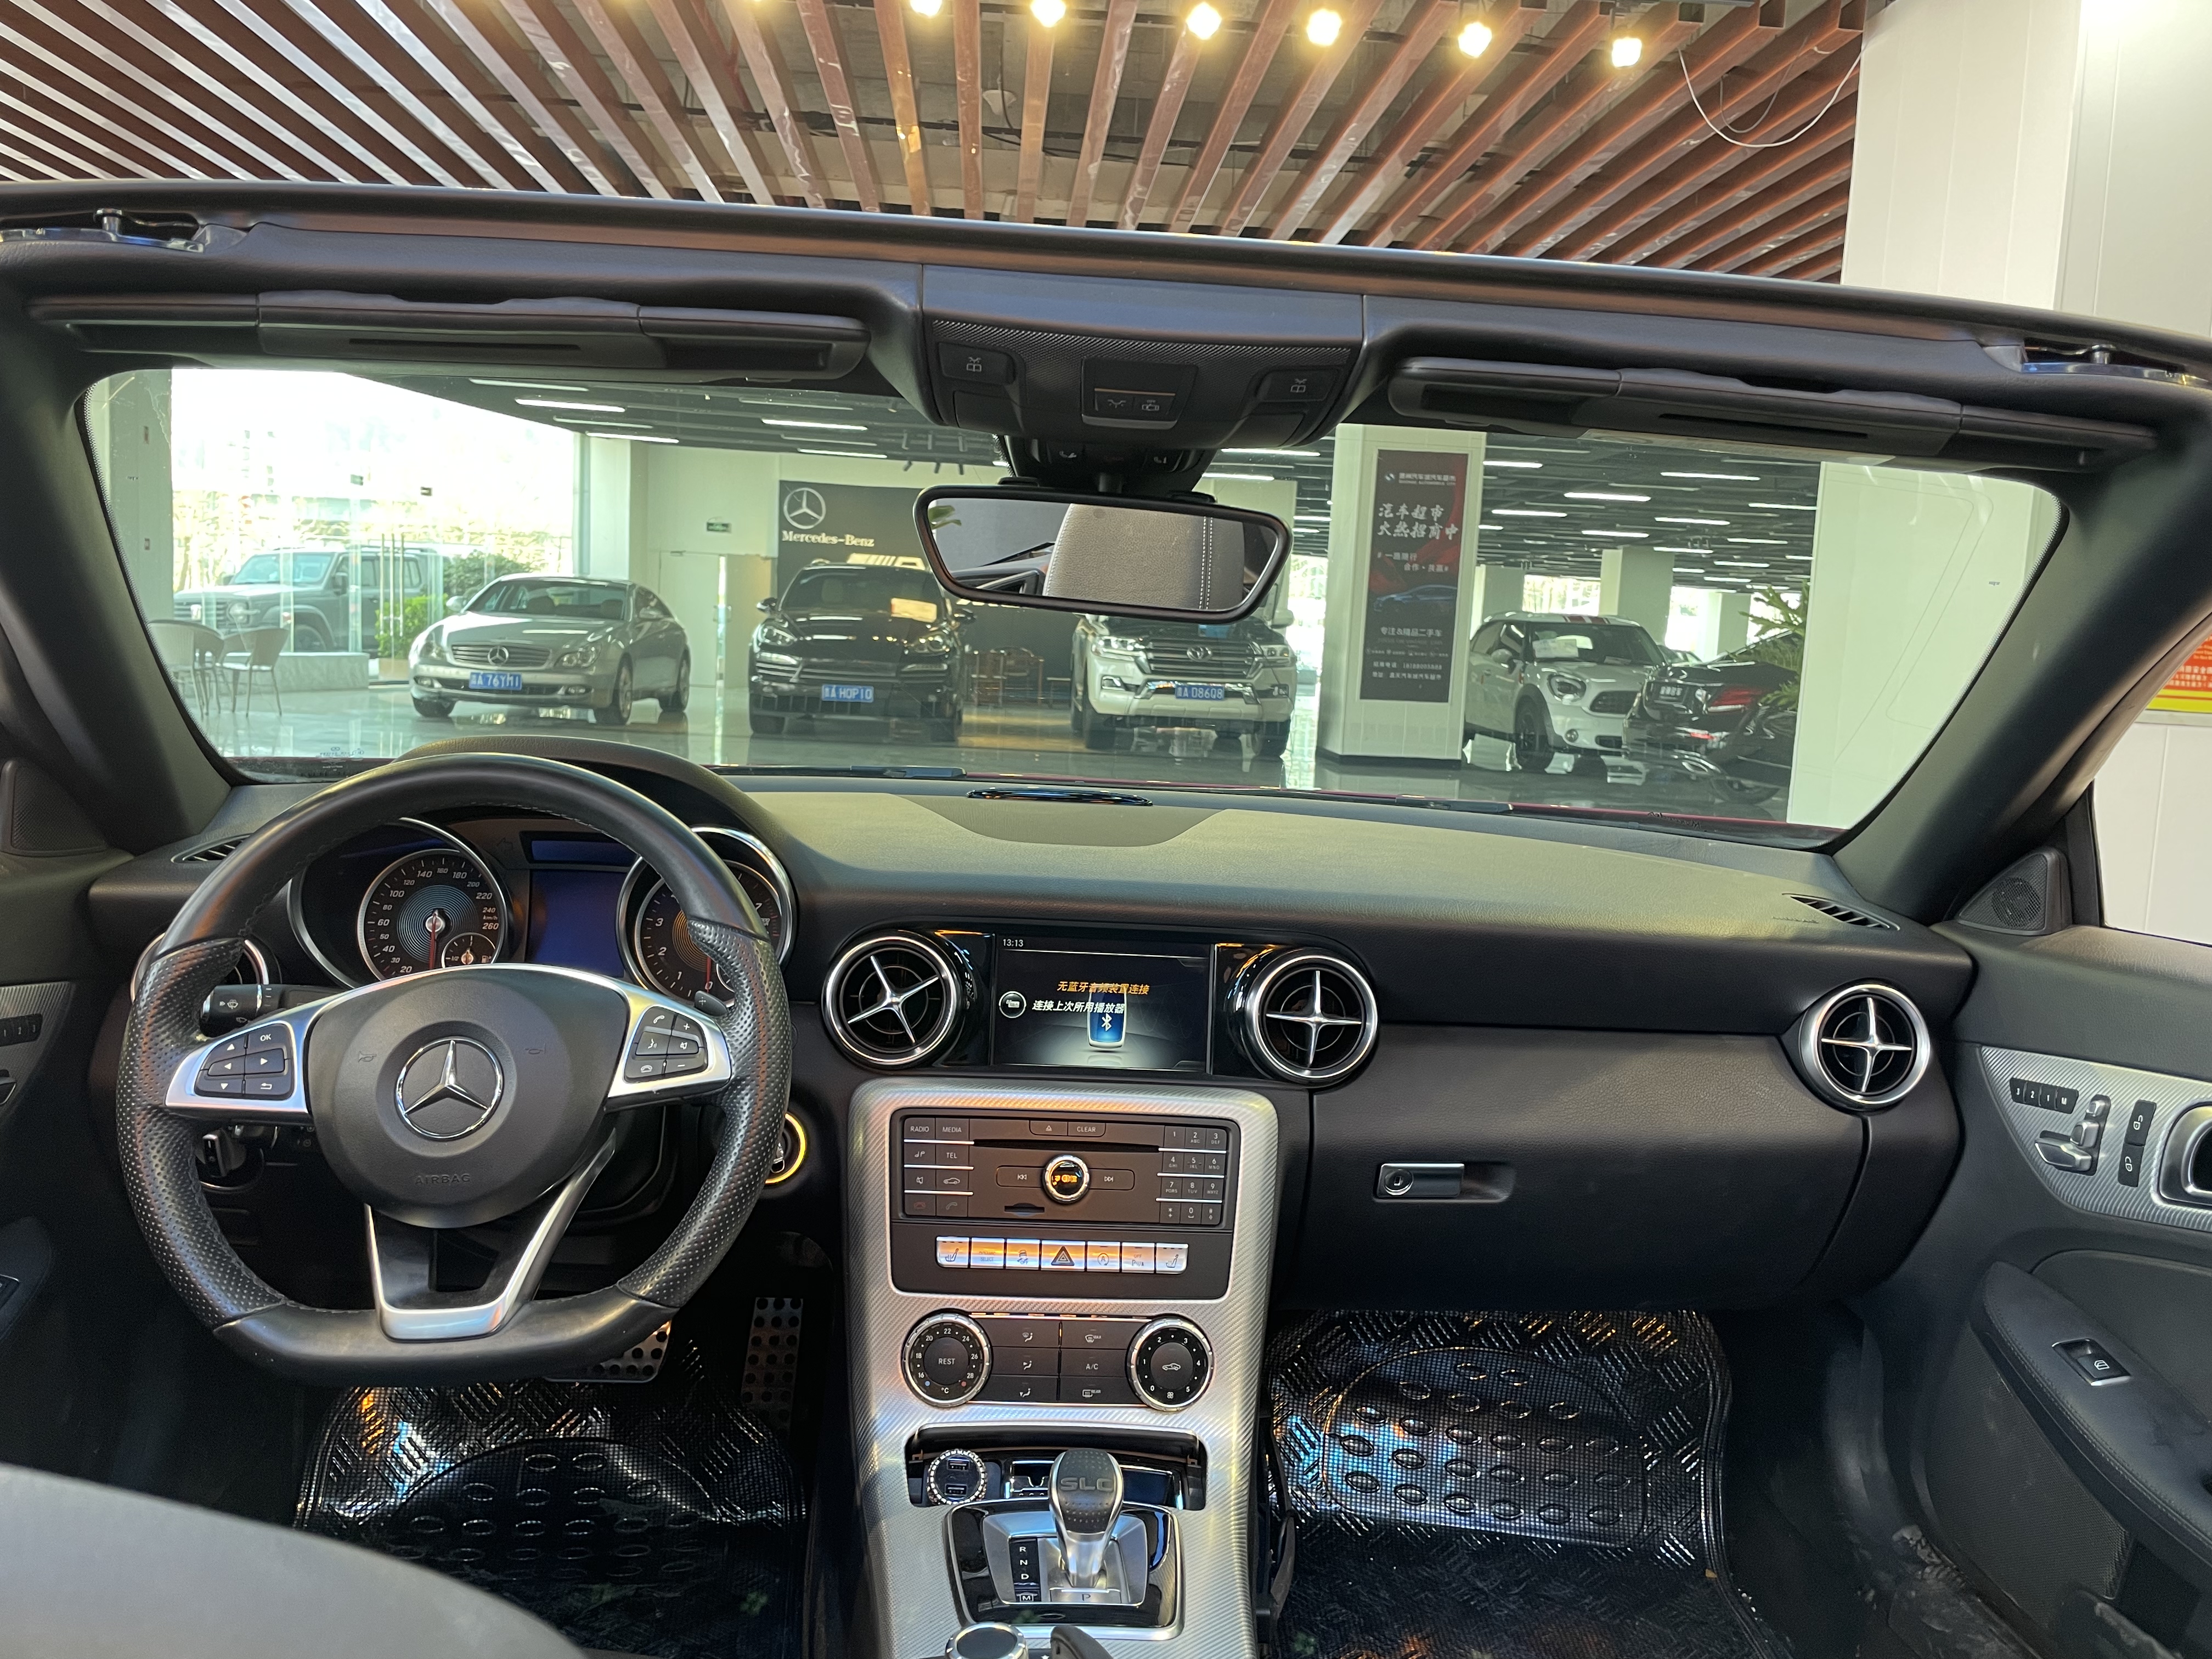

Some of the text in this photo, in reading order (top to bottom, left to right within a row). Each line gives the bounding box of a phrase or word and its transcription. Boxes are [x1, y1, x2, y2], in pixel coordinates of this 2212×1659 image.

[782, 530, 874, 547] Mercedes-Benz
[656, 918, 663, 927] 3
[1002, 939, 1024, 947] 13:13
[658, 947, 667, 956] 2
[678, 972, 682, 980] 1
[705, 981, 713, 990] 0
[1057, 981, 1150, 995] 无蓝牙音频装置连接
[1032, 1000, 1125, 1014] 连接上次所用播放器
[415, 1173, 471, 1186] AIRBAG
[1060, 1477, 1114, 1492] SLC
